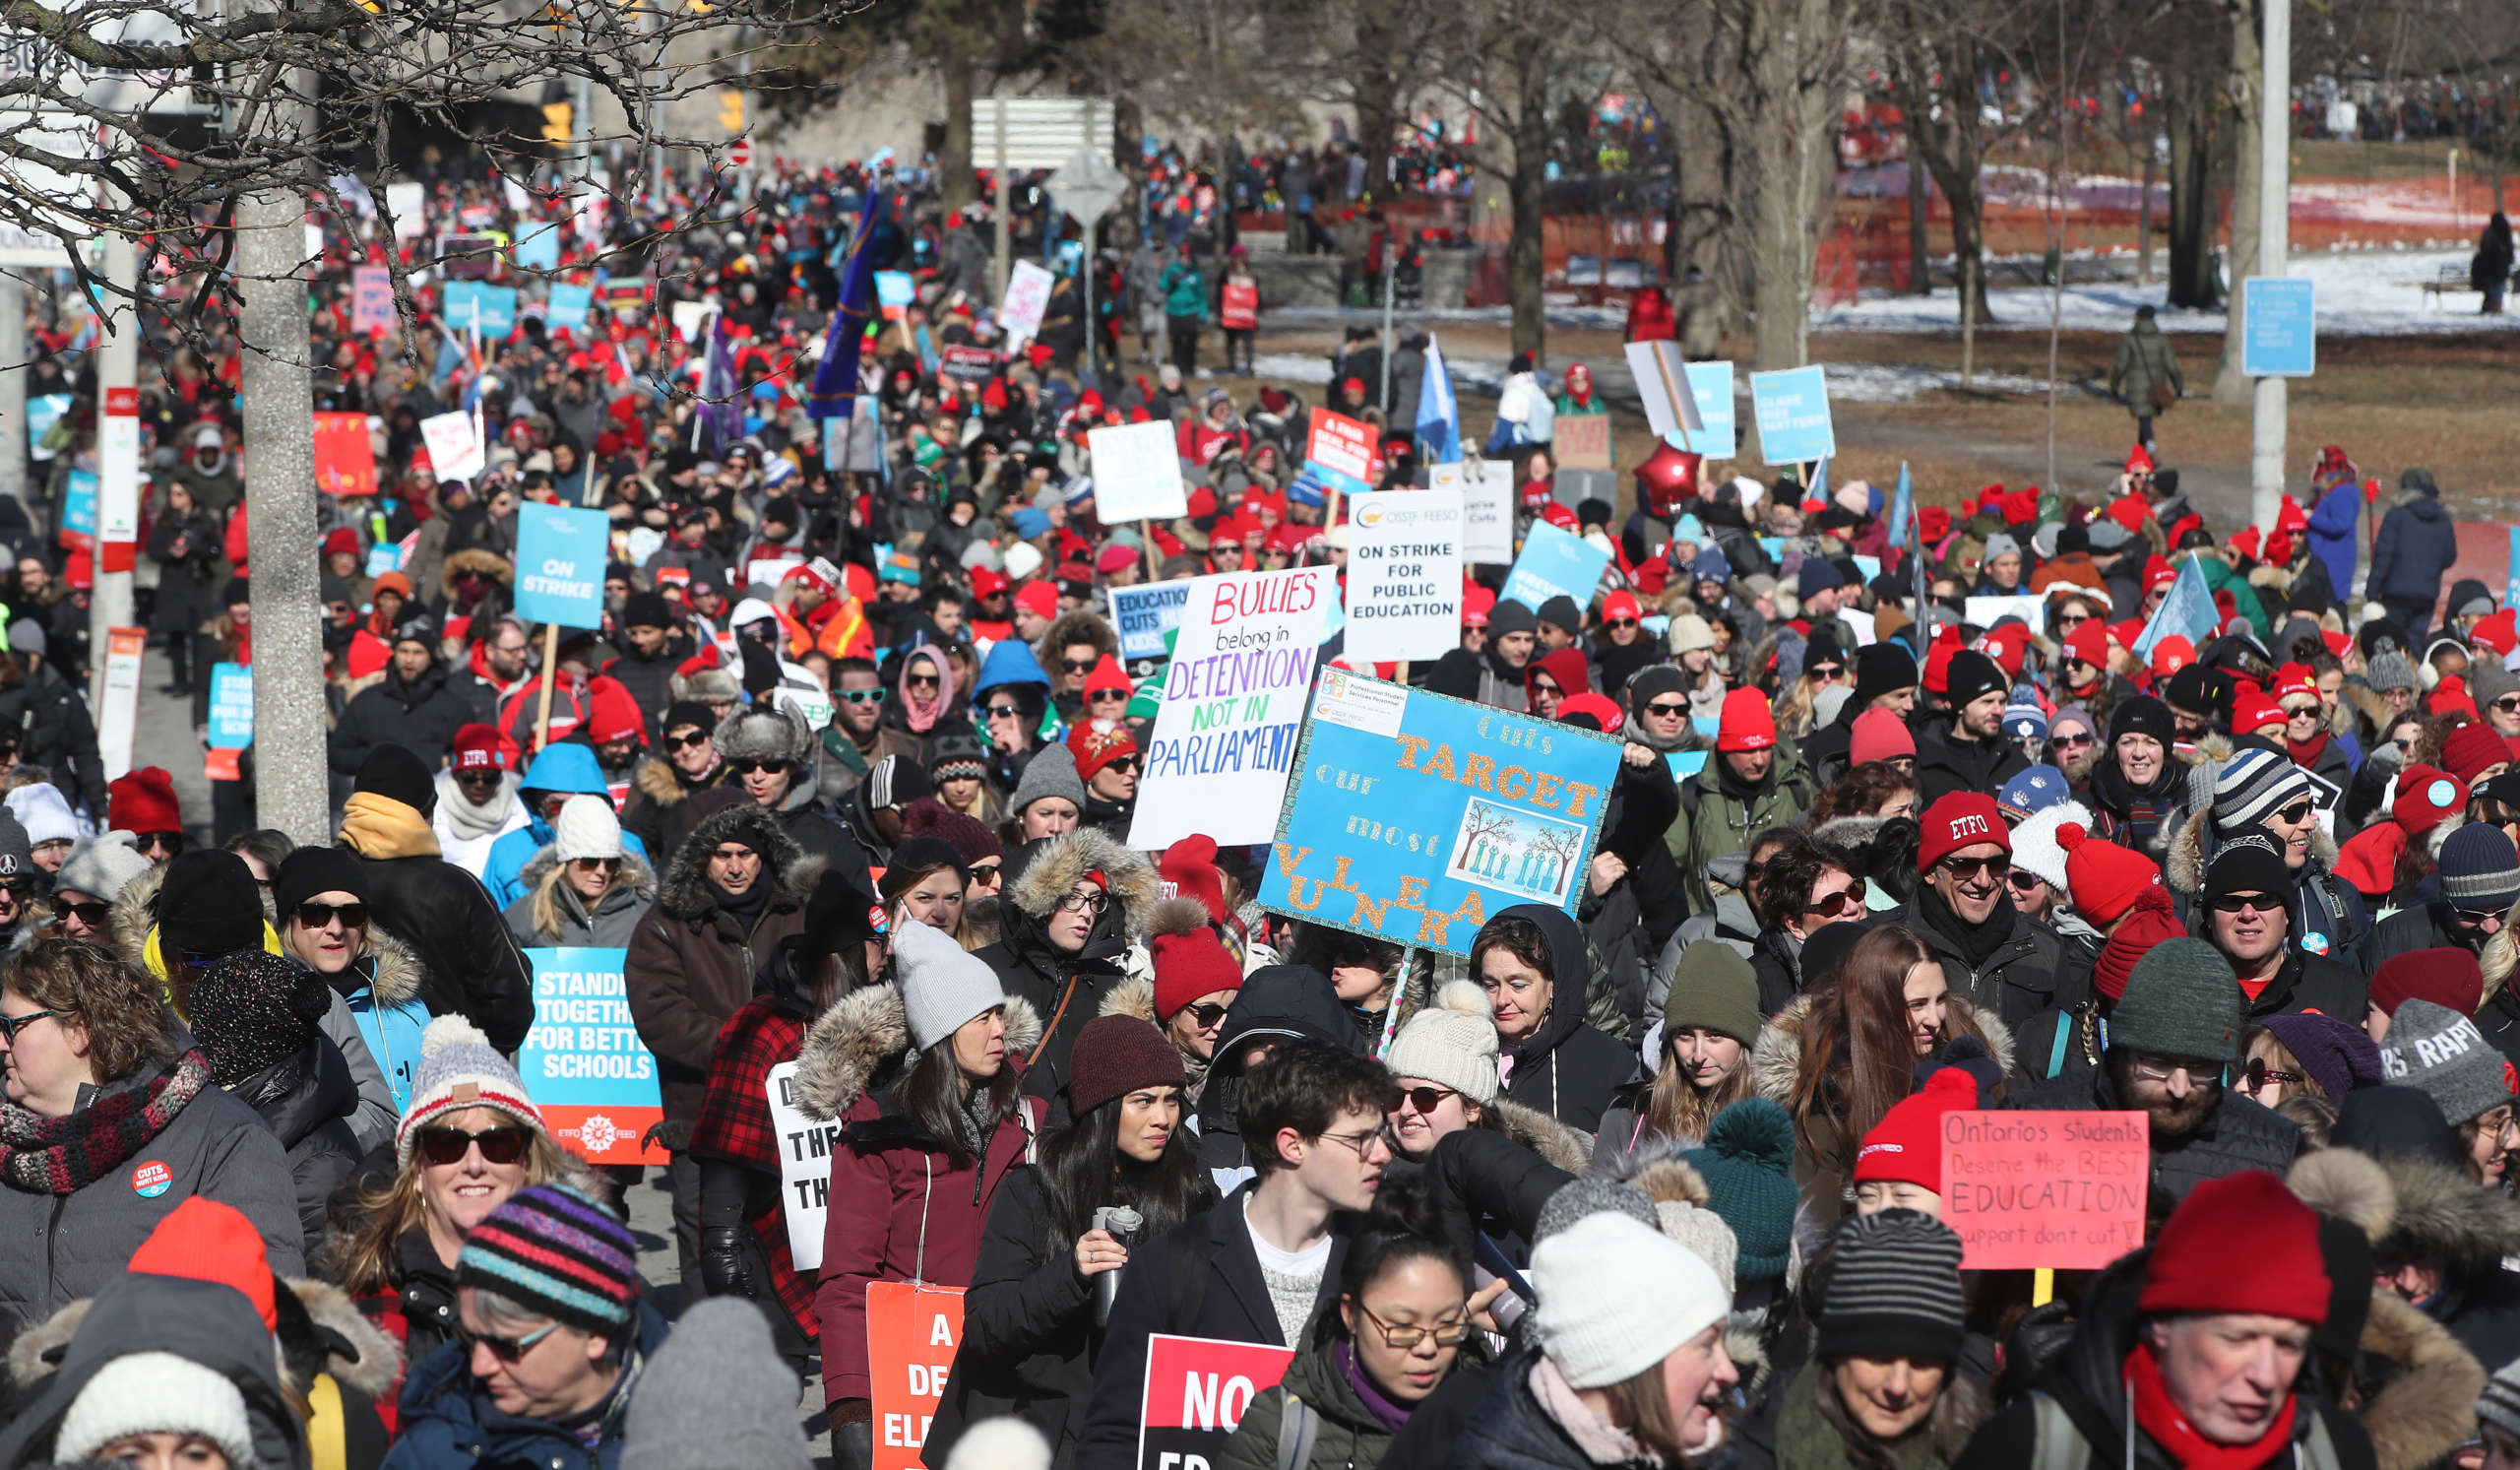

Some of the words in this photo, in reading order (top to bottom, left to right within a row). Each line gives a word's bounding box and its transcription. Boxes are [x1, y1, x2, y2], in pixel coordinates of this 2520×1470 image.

[1359, 545, 1383, 558] ON
[1390, 543, 1453, 557] STRIKE
[542, 559, 575, 579] ON
[1388, 564, 1422, 578] FOR
[523, 574, 594, 600] STRIKE
[1118, 588, 1189, 610] EDUCATIO
[1211, 572, 1317, 625] BULLIES
[1373, 583, 1435, 598] PUBLIC
[1122, 612, 1159, 633] CUTS
[1354, 603, 1454, 618] EDUCATION
[1216, 625, 1271, 653] belong
[1277, 625, 1289, 642] in
[1167, 647, 1312, 701] DETENTION
[1191, 698, 1239, 732] NOT
[1244, 694, 1270, 722] IN
[1477, 715, 1552, 754] Cuts
[1147, 723, 1300, 779] PARLIAMENT
[1315, 764, 1380, 796] our
[1396, 733, 1598, 817] TARGET
[1346, 814, 1441, 857] most
[1950, 814, 1988, 840] ETFO
[537, 999, 635, 1024] TOGETH
[527, 1027, 574, 1051] FOR
[543, 1054, 651, 1079] SCHOOLS
[1945, 1115, 2048, 1144] Ontario's
[138, 1165, 164, 1179] CUTS
[1952, 1153, 2024, 1175] Deserve
[2035, 1152, 2064, 1174] the
[2078, 1150, 2143, 1176] BEST
[136, 1178, 153, 1187] HURT
[153, 1173, 168, 1182] KIDS
[1952, 1180, 2140, 1213] EDUCATION
[2087, 1223, 2116, 1245] cut
[929, 1313, 954, 1347] A
[1182, 1371, 1255, 1434] NO
